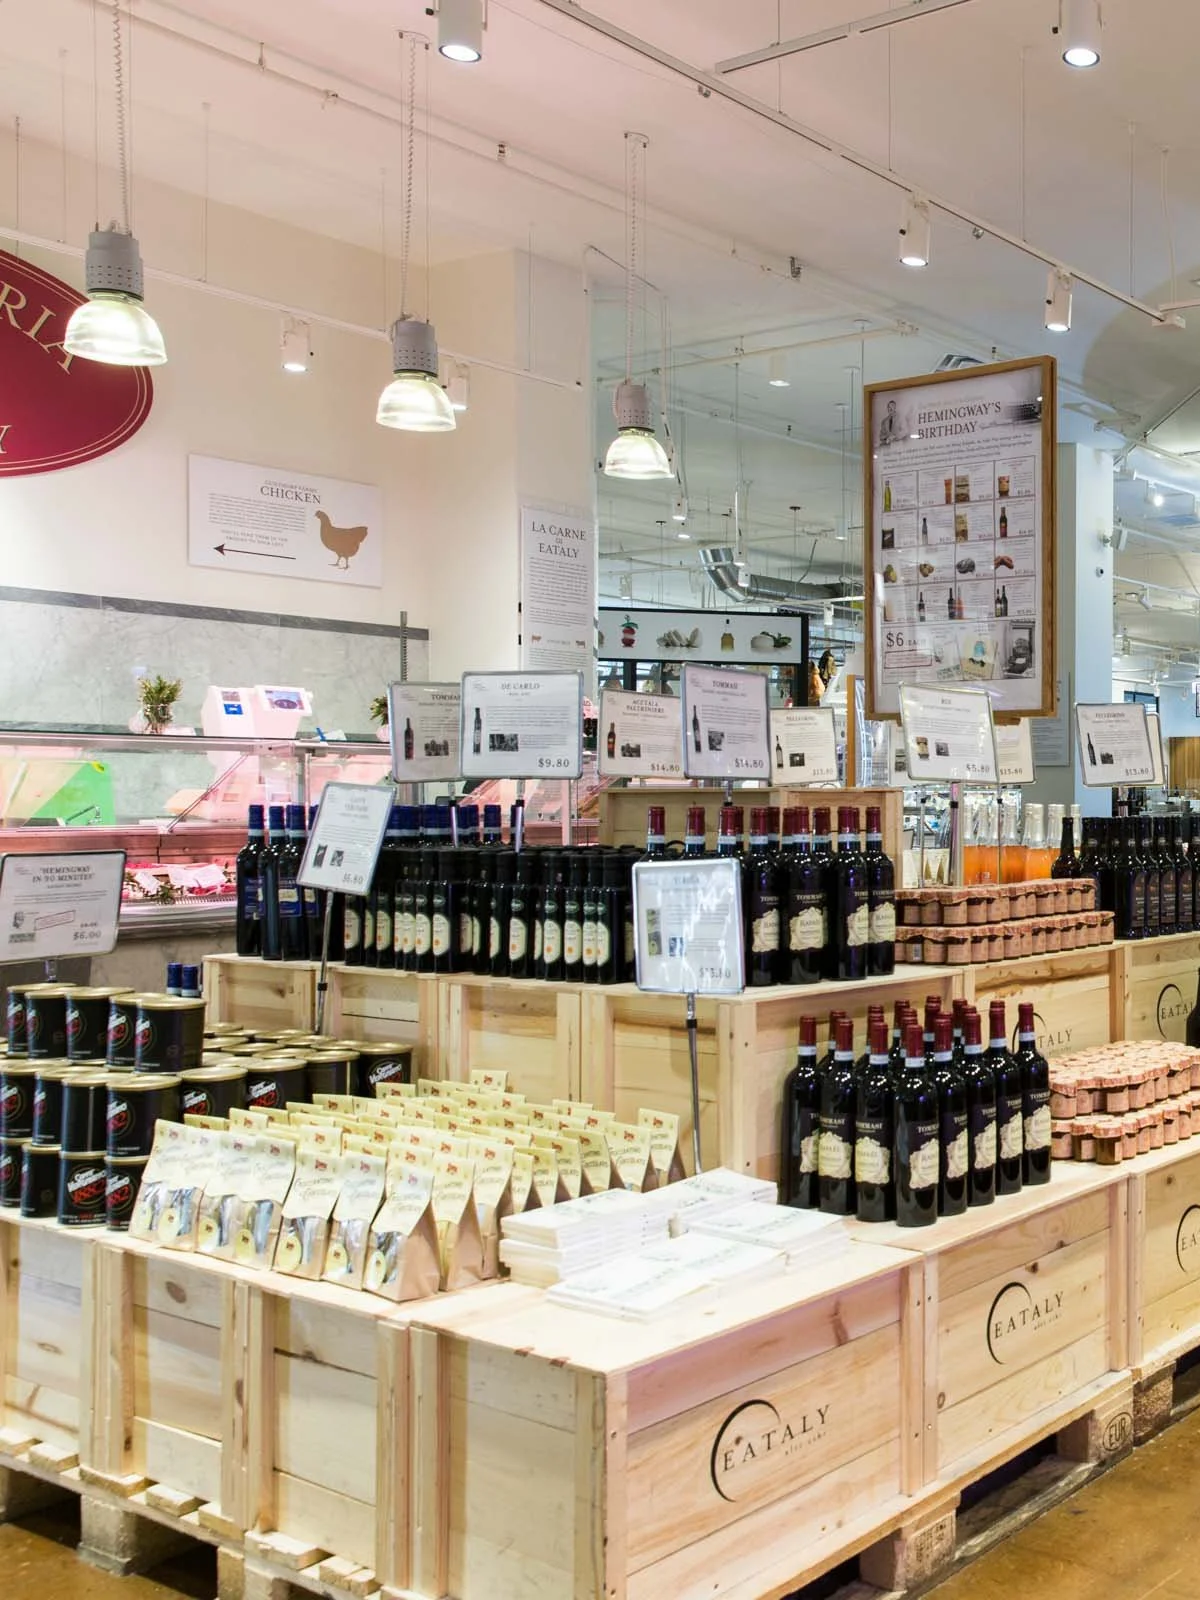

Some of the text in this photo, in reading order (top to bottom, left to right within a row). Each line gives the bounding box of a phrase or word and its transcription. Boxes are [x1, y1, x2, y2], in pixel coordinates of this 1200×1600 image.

[917, 421, 978, 439] BIRTHDAY
[260, 486, 321, 504] CHICKEN
[532, 521, 587, 541] LA CARNE
[538, 543, 580, 558] EATALY
[886, 632, 904, 648] $6
[538, 757, 570, 768] $9.80
[650, 763, 680, 772] $14.80
[734, 758, 764, 769] $14.80
[994, 1290, 1064, 1340] EATALY
[722, 1404, 830, 1472] EATALY
